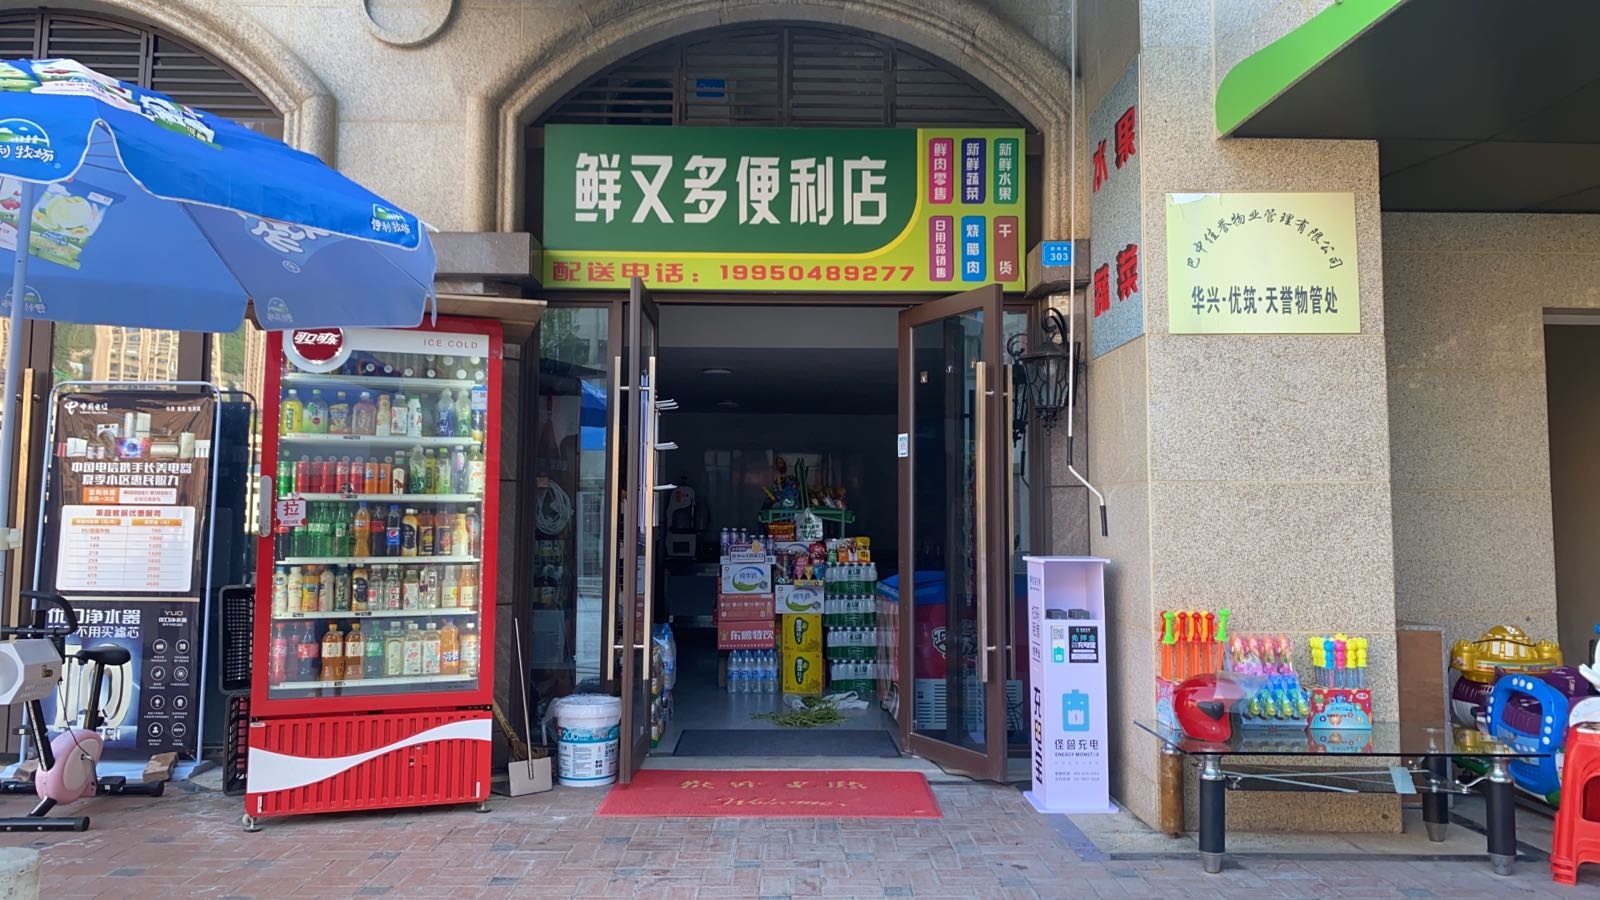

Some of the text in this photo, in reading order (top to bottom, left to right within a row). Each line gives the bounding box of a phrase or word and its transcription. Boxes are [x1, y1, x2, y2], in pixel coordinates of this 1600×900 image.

[1092, 105, 1137, 192] 水果
[575, 152, 888, 226] 鲜又多便利店
[933, 143, 947, 201] 鲜肉零售
[966, 143, 980, 201] 新鲜蔬菜
[998, 143, 1012, 201] 新鲜水果
[935, 220, 947, 279] 日用品销售
[966, 224, 980, 275] 烧腊肉
[998, 223, 1012, 275] 干货
[1050, 252, 1069, 262] 303
[720, 265, 915, 281] 19950489277
[1093, 243, 1139, 318] 蔬菜
[1192, 285, 1339, 315] 华兴·优筑·天誉物管处
[293, 331, 341, 346] 可口可乐
[424, 339, 478, 349] ICE COLD
[79, 402, 108, 411] 中国电信
[283, 501, 300, 517] 拉
[730, 630, 774, 641] 东鹏特饮
[1055, 739, 1099, 750] 怪兽充电
